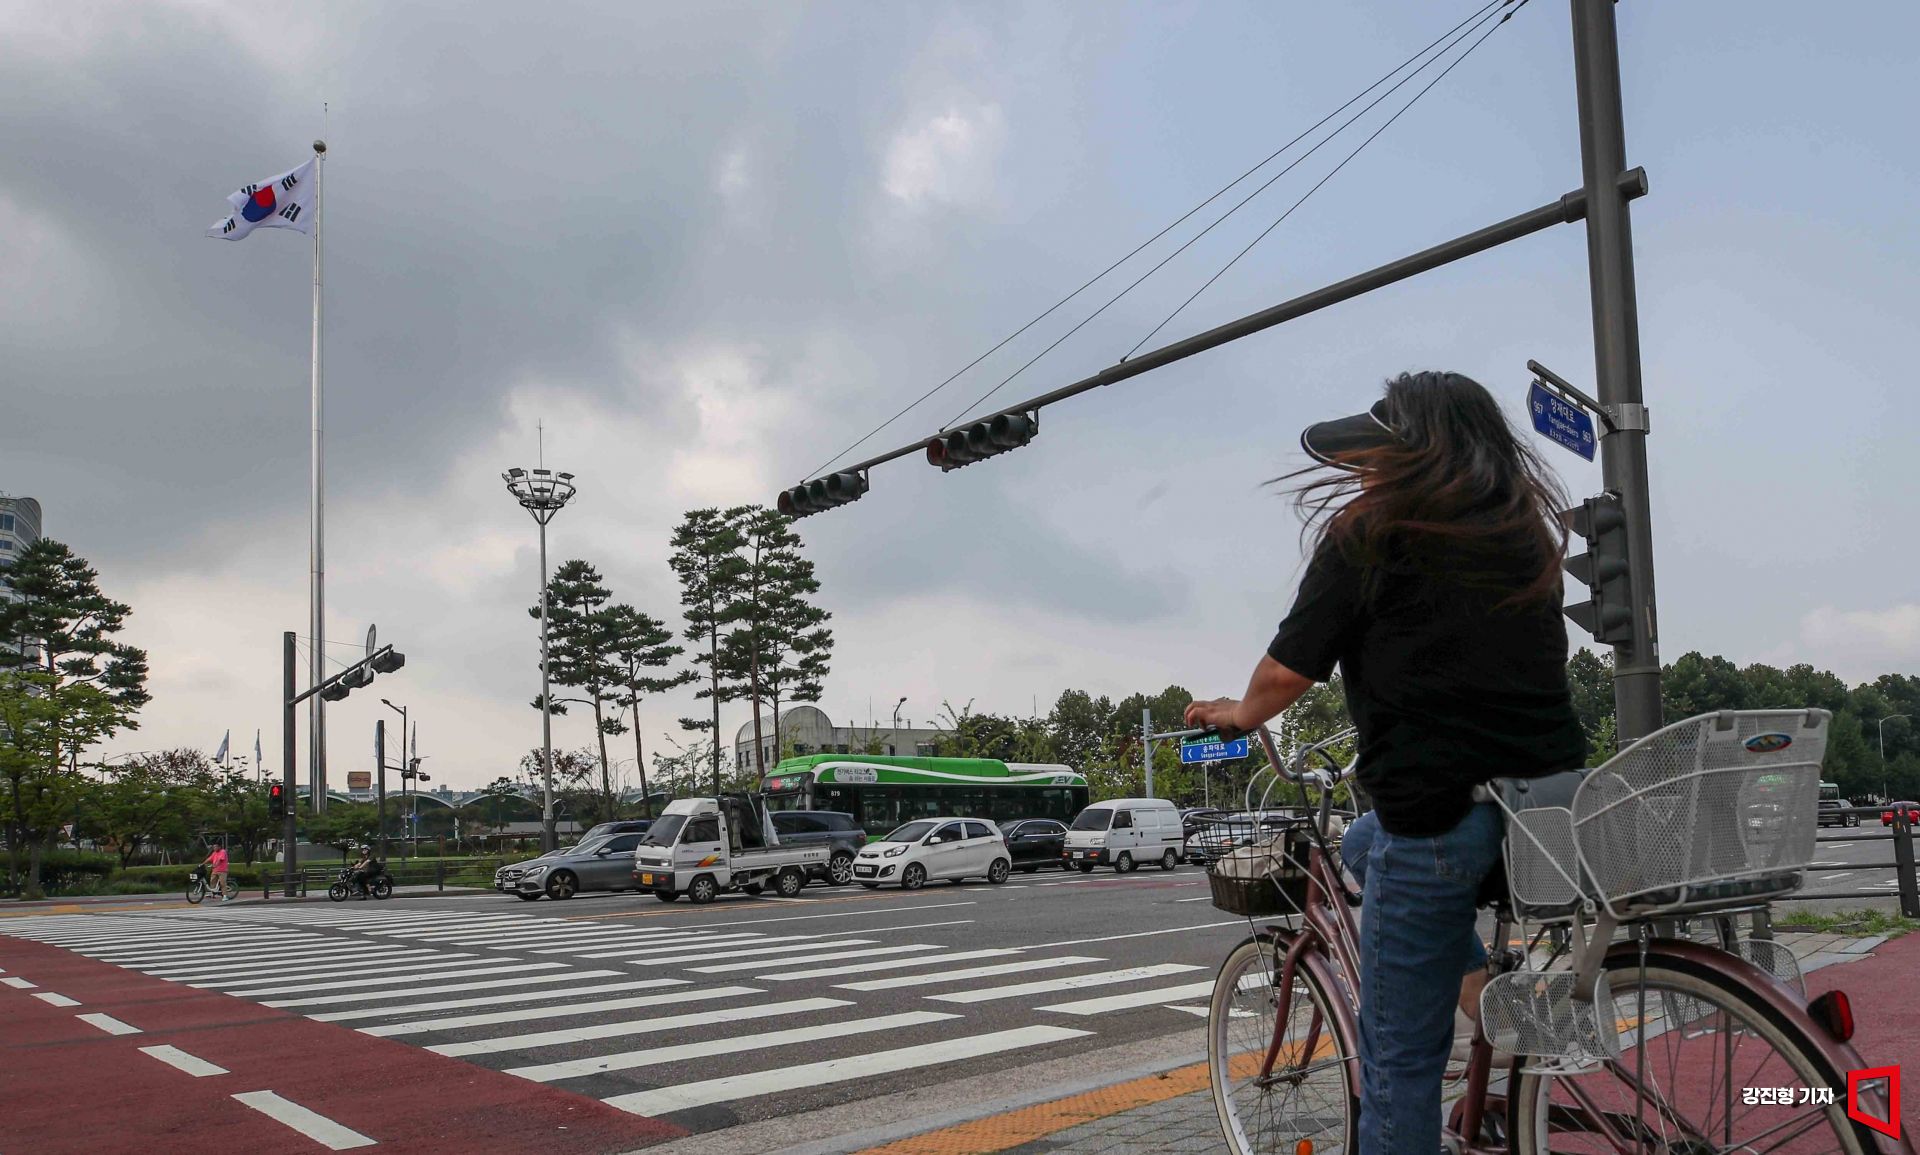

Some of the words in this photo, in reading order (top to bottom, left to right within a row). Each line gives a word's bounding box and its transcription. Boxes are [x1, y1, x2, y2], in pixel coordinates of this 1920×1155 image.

[1551, 398, 1575, 423] 양재대로
[1203, 743, 1225, 753] 송파대로
[1056, 776, 1071, 784] EV
